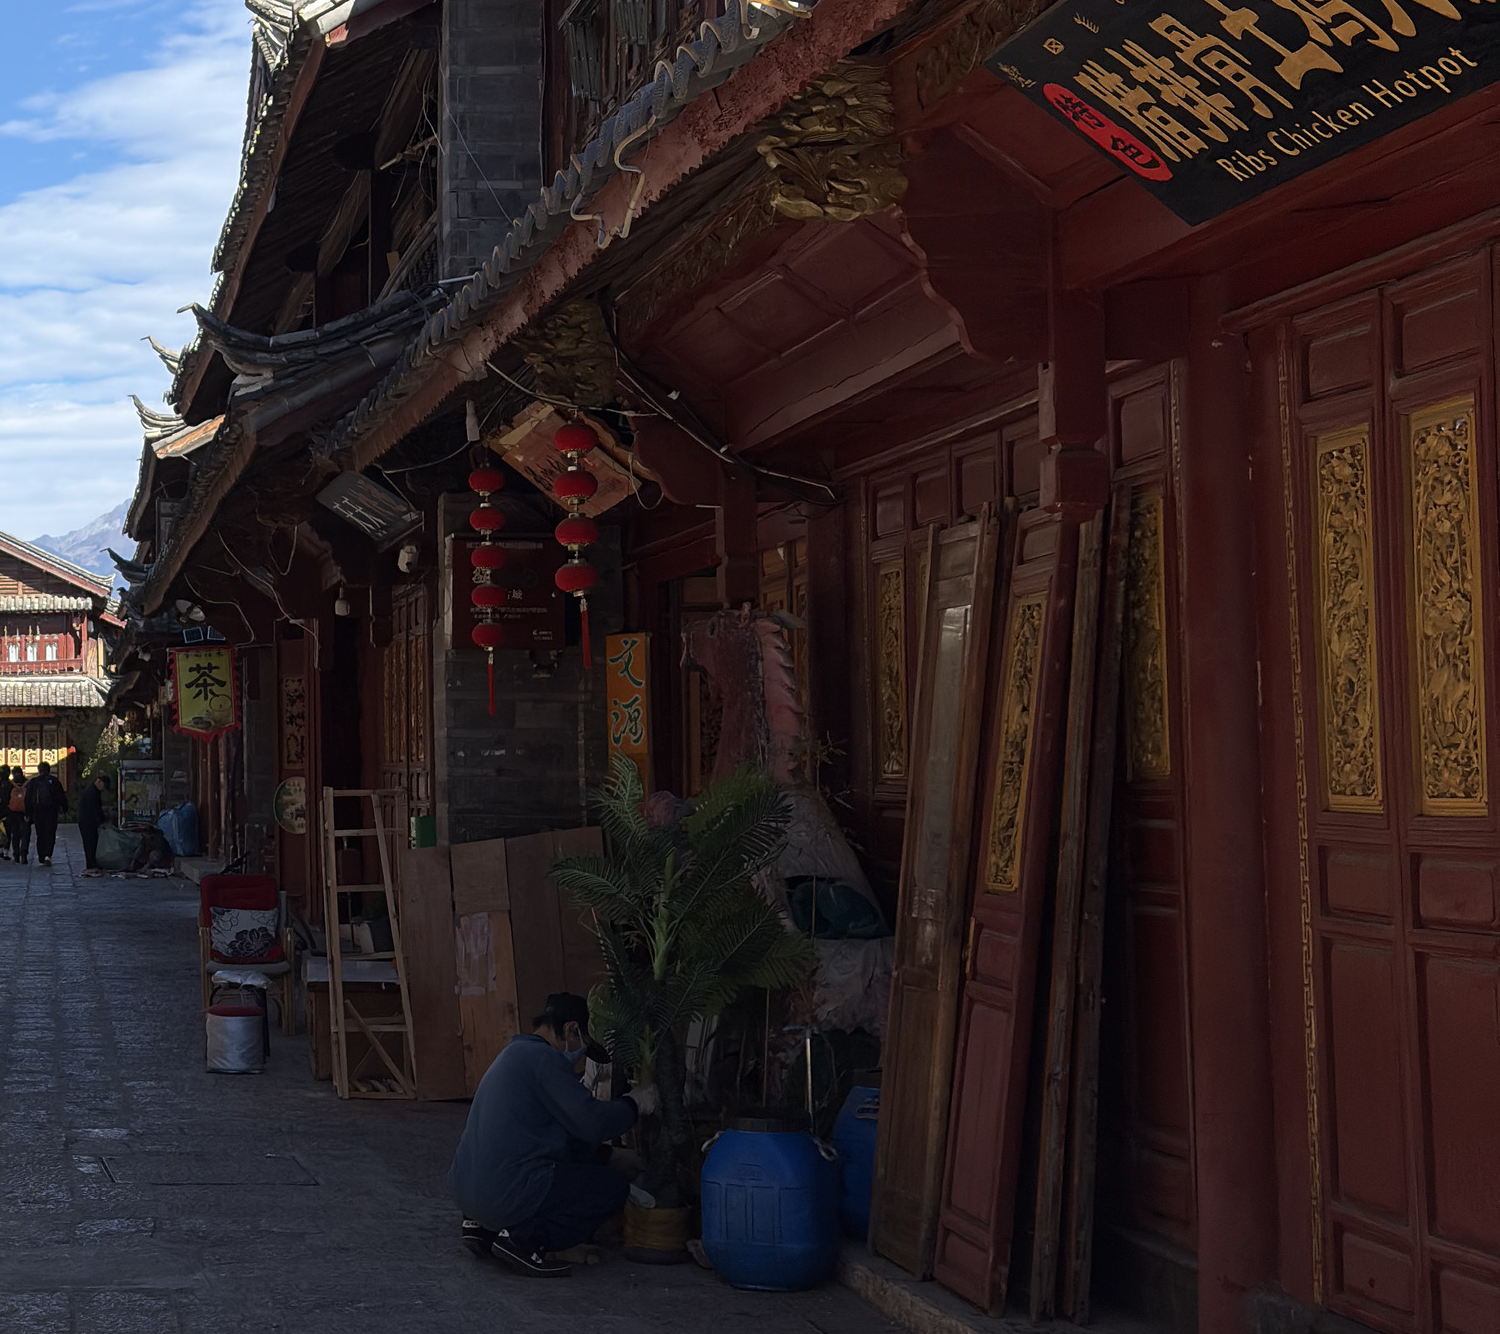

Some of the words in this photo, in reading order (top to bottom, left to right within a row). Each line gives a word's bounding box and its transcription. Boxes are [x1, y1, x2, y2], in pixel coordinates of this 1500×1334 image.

[1053, 94, 1162, 171] 特色
[1216, 143, 1276, 183] Ribs
[1273, 100, 1371, 157] Chicken
[1371, 46, 1478, 109] Hotpot
[185, 662, 227, 701] 茶
